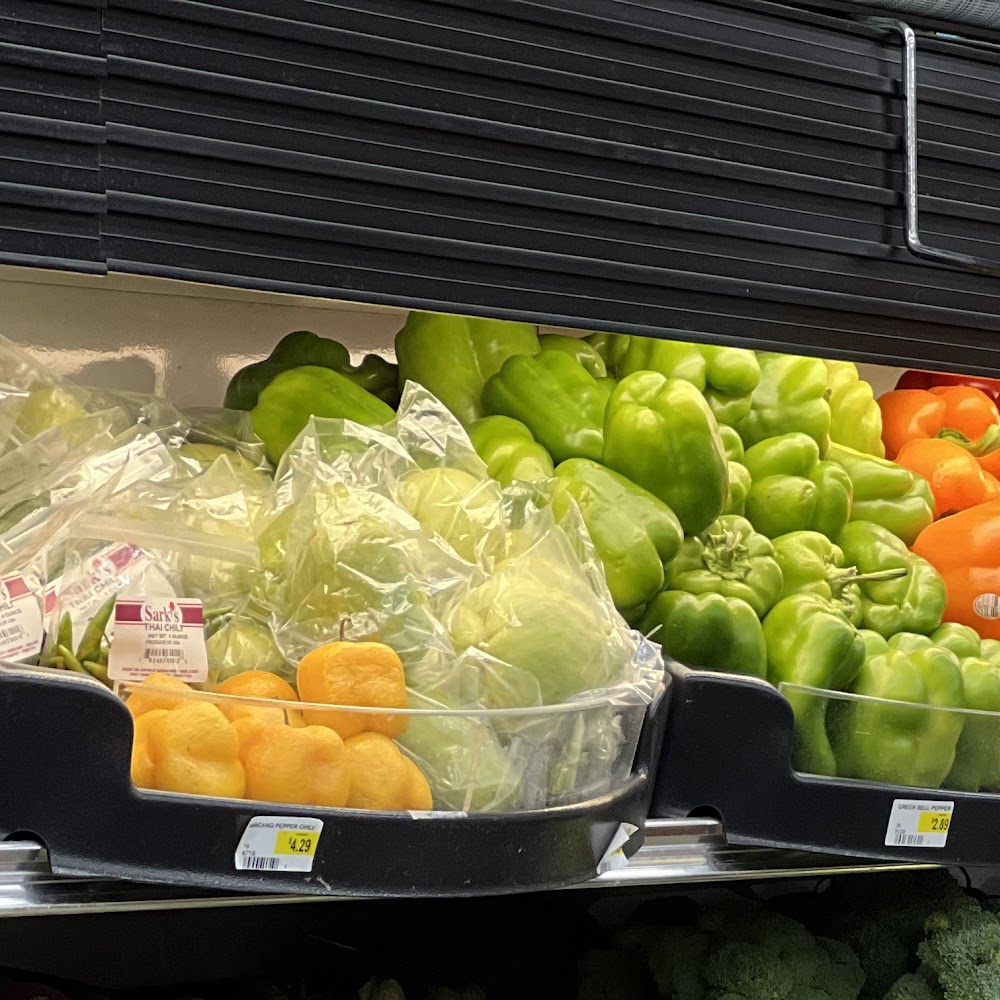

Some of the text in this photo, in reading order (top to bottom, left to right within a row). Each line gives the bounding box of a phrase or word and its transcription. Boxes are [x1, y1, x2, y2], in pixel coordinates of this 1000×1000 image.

[144, 602, 180, 623] Sark's
[144, 623, 163, 632] THAI
[275, 822, 298, 830] PEPPER
[288, 836, 312, 853] $4.29
